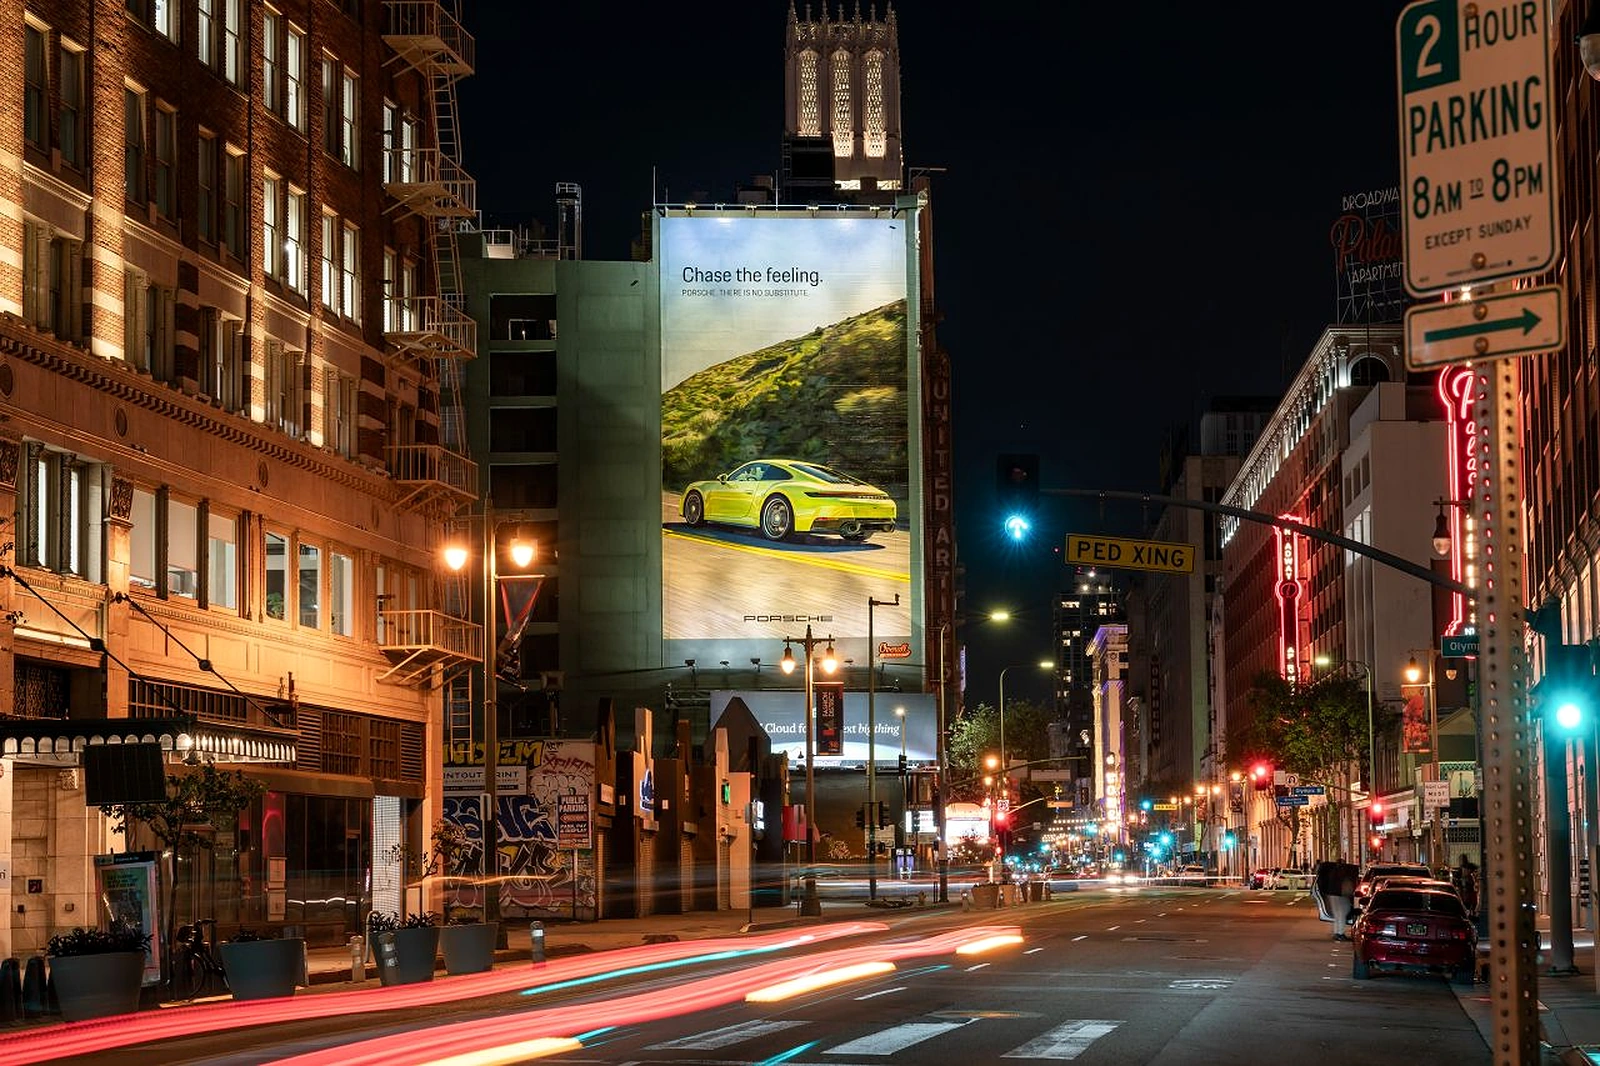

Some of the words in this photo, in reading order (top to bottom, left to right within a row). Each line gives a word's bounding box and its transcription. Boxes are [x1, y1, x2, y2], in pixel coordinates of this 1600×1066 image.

[1414, 14, 1442, 79] 2
[1464, 1, 1537, 50] HOUR
[1410, 75, 1541, 156] PARKING
[1342, 187, 1400, 211] BROADWA
[1470, 178, 1484, 198] TO
[1425, 227, 1471, 249] EXCEPT
[1479, 215, 1532, 240] SUNDAY
[1330, 214, 1402, 274] Pala
[682, 267, 732, 283] Chase
[736, 267, 762, 283] the
[766, 267, 824, 287] feeling.
[1351, 262, 1402, 284] APARTME
[719, 289, 742, 297] THERE
[743, 289, 750, 297] IS
[751, 289, 763, 297] NO
[1078, 541, 1121, 561] PED
[1132, 545, 1185, 567] XING
[743, 615, 834, 623] PORSCHE
[1449, 641, 1480, 653] Olym
[765, 723, 796, 734] Cloud
[798, 723, 807, 734] fo
[843, 724, 857, 734] ext
[858, 723, 871, 736] big
[874, 723, 900, 737] thing
